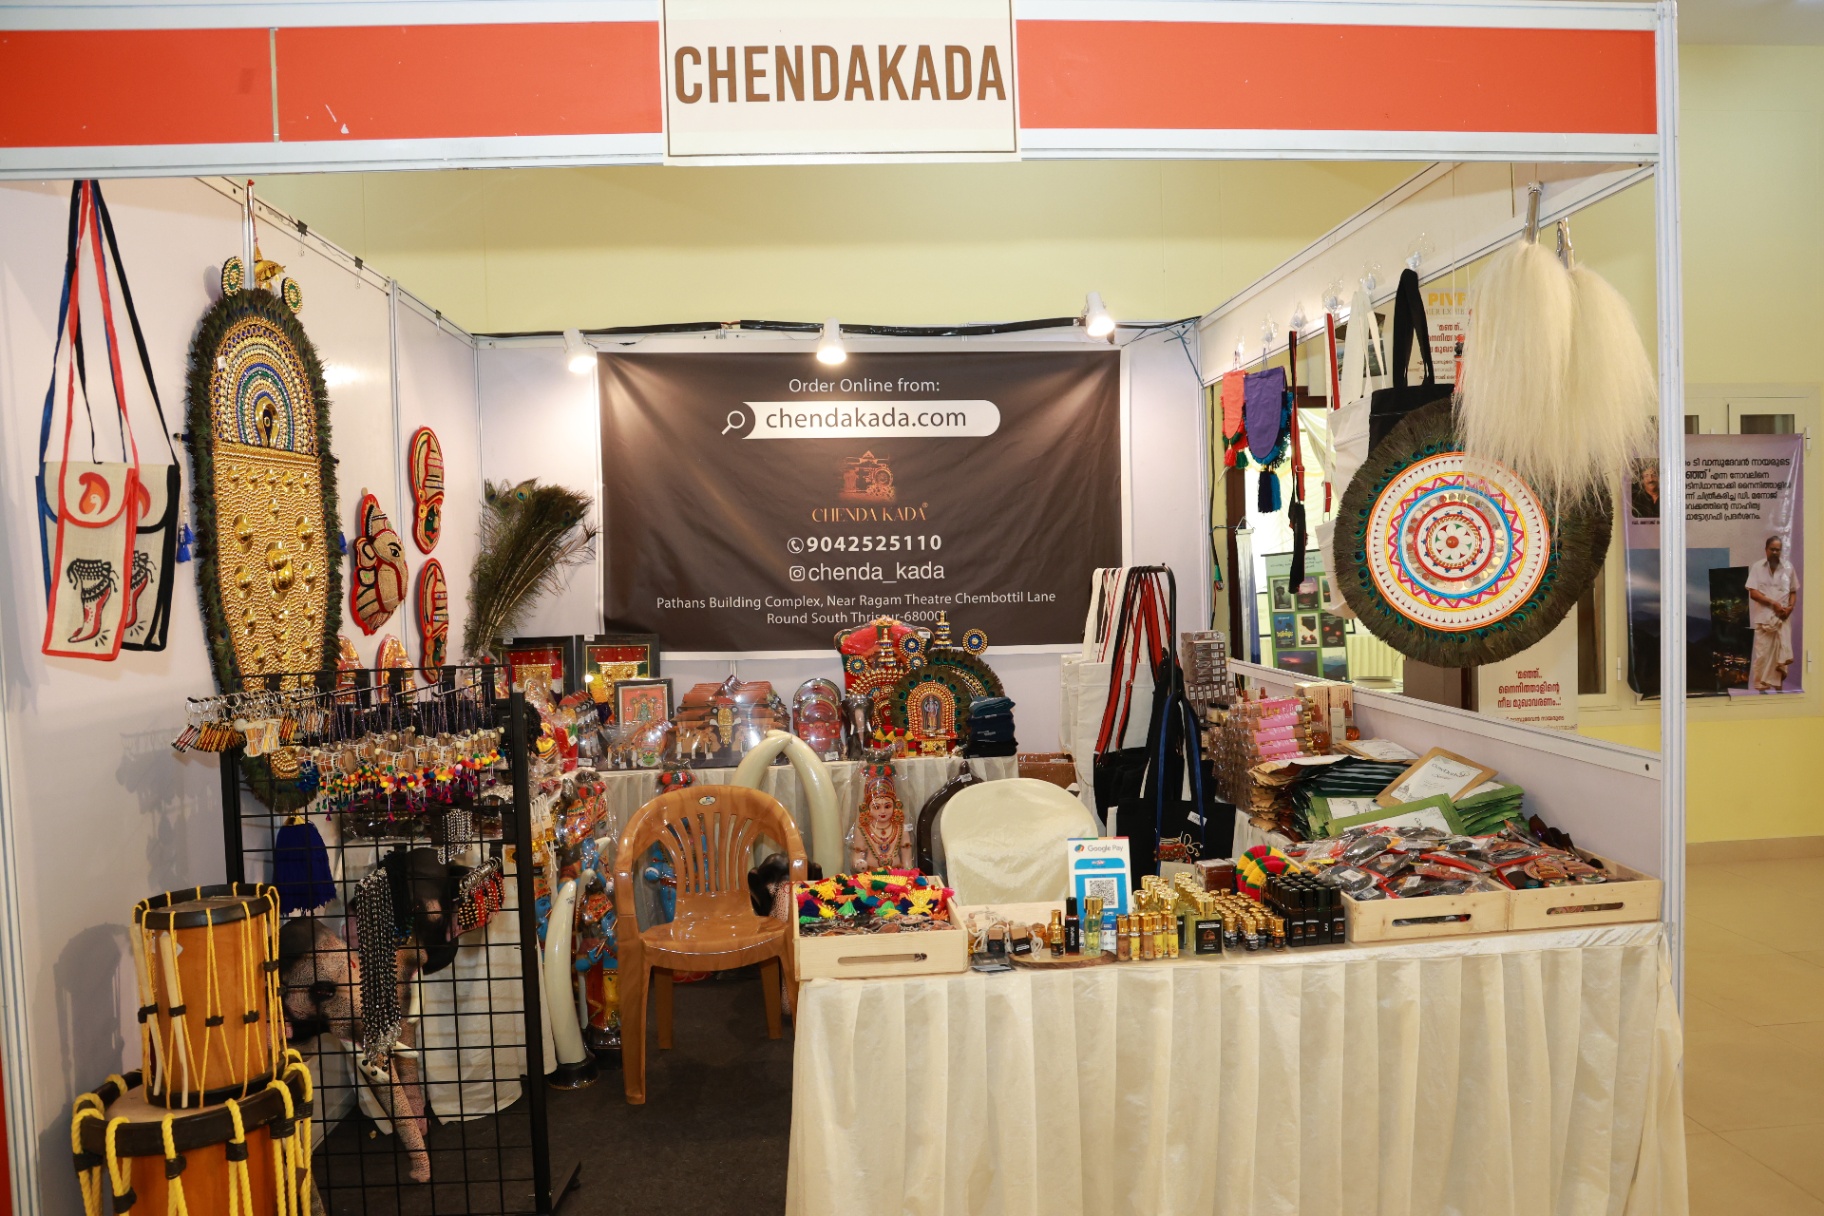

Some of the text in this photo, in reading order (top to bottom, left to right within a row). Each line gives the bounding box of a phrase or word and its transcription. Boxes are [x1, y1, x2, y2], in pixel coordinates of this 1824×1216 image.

[674, 45, 1006, 104] CHENDAKADA
[788, 377, 941, 393] Order Online from:
[765, 406, 967, 429] chendakada.com
[811, 507, 878, 523] CHENDA
[806, 534, 943, 553] 9042525110
[808, 561, 946, 584] chenda_kada
[656, 592, 1056, 611] Pathans Building Complex, Near Ragam Theatre Chembottil Lane
[767, 612, 808, 624] Round
[811, 611, 848, 624] South
[1087, 843, 1124, 853] Google Pay
